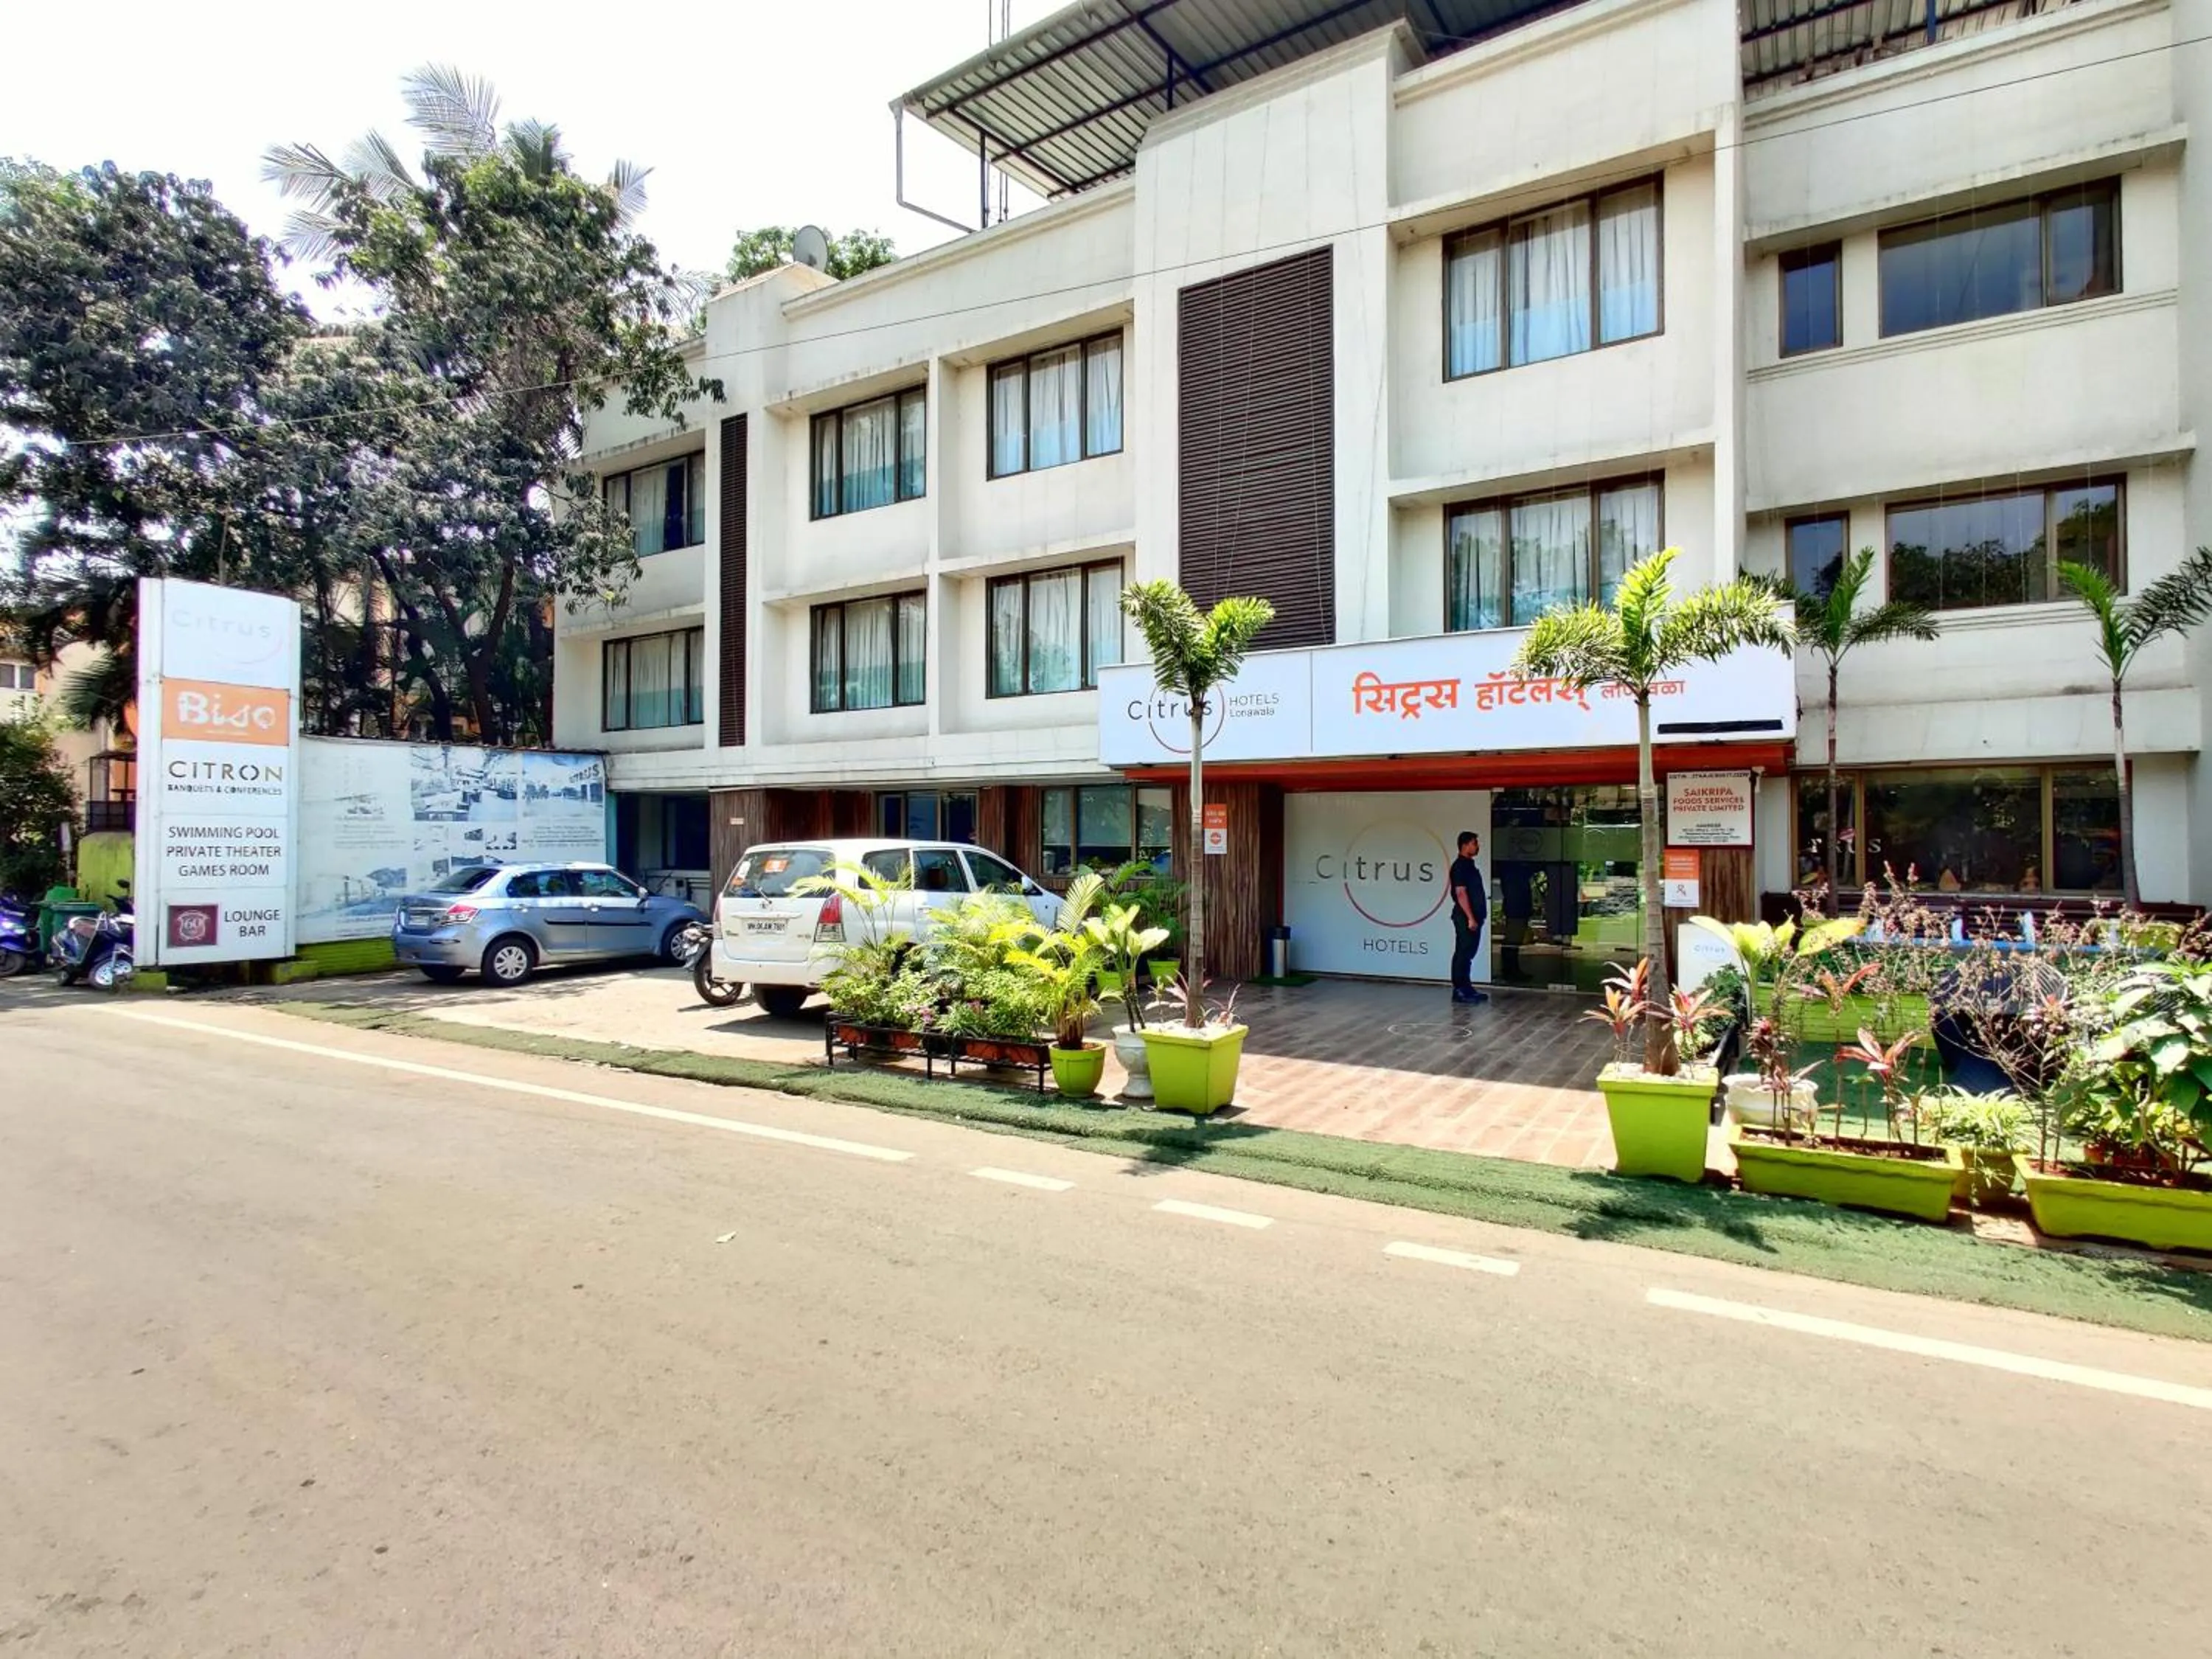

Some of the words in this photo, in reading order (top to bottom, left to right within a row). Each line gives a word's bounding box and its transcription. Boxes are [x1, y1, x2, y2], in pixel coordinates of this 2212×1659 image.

[1229, 693, 1279, 706] HOTELS
[1352, 672, 1461, 719] सिट्रस
[1230, 708, 1275, 718] Lonawala
[168, 760, 282, 782] CITRON
[167, 784, 214, 793] BANQUETS
[224, 786, 282, 796] CONFERENCES
[1684, 787, 1733, 796] SAIKRIPA
[168, 826, 243, 838] SWIMMING
[246, 827, 280, 838] POOL
[166, 846, 222, 858] PRIVATE
[226, 846, 282, 858] THEATER
[178, 864, 226, 877] GAMES
[229, 864, 269, 875] ROOM
[1316, 854, 1433, 882] Citrus
[224, 909, 280, 922] LOUNGE
[239, 926, 266, 937] BAR
[1363, 938, 1428, 955] HOTELS
